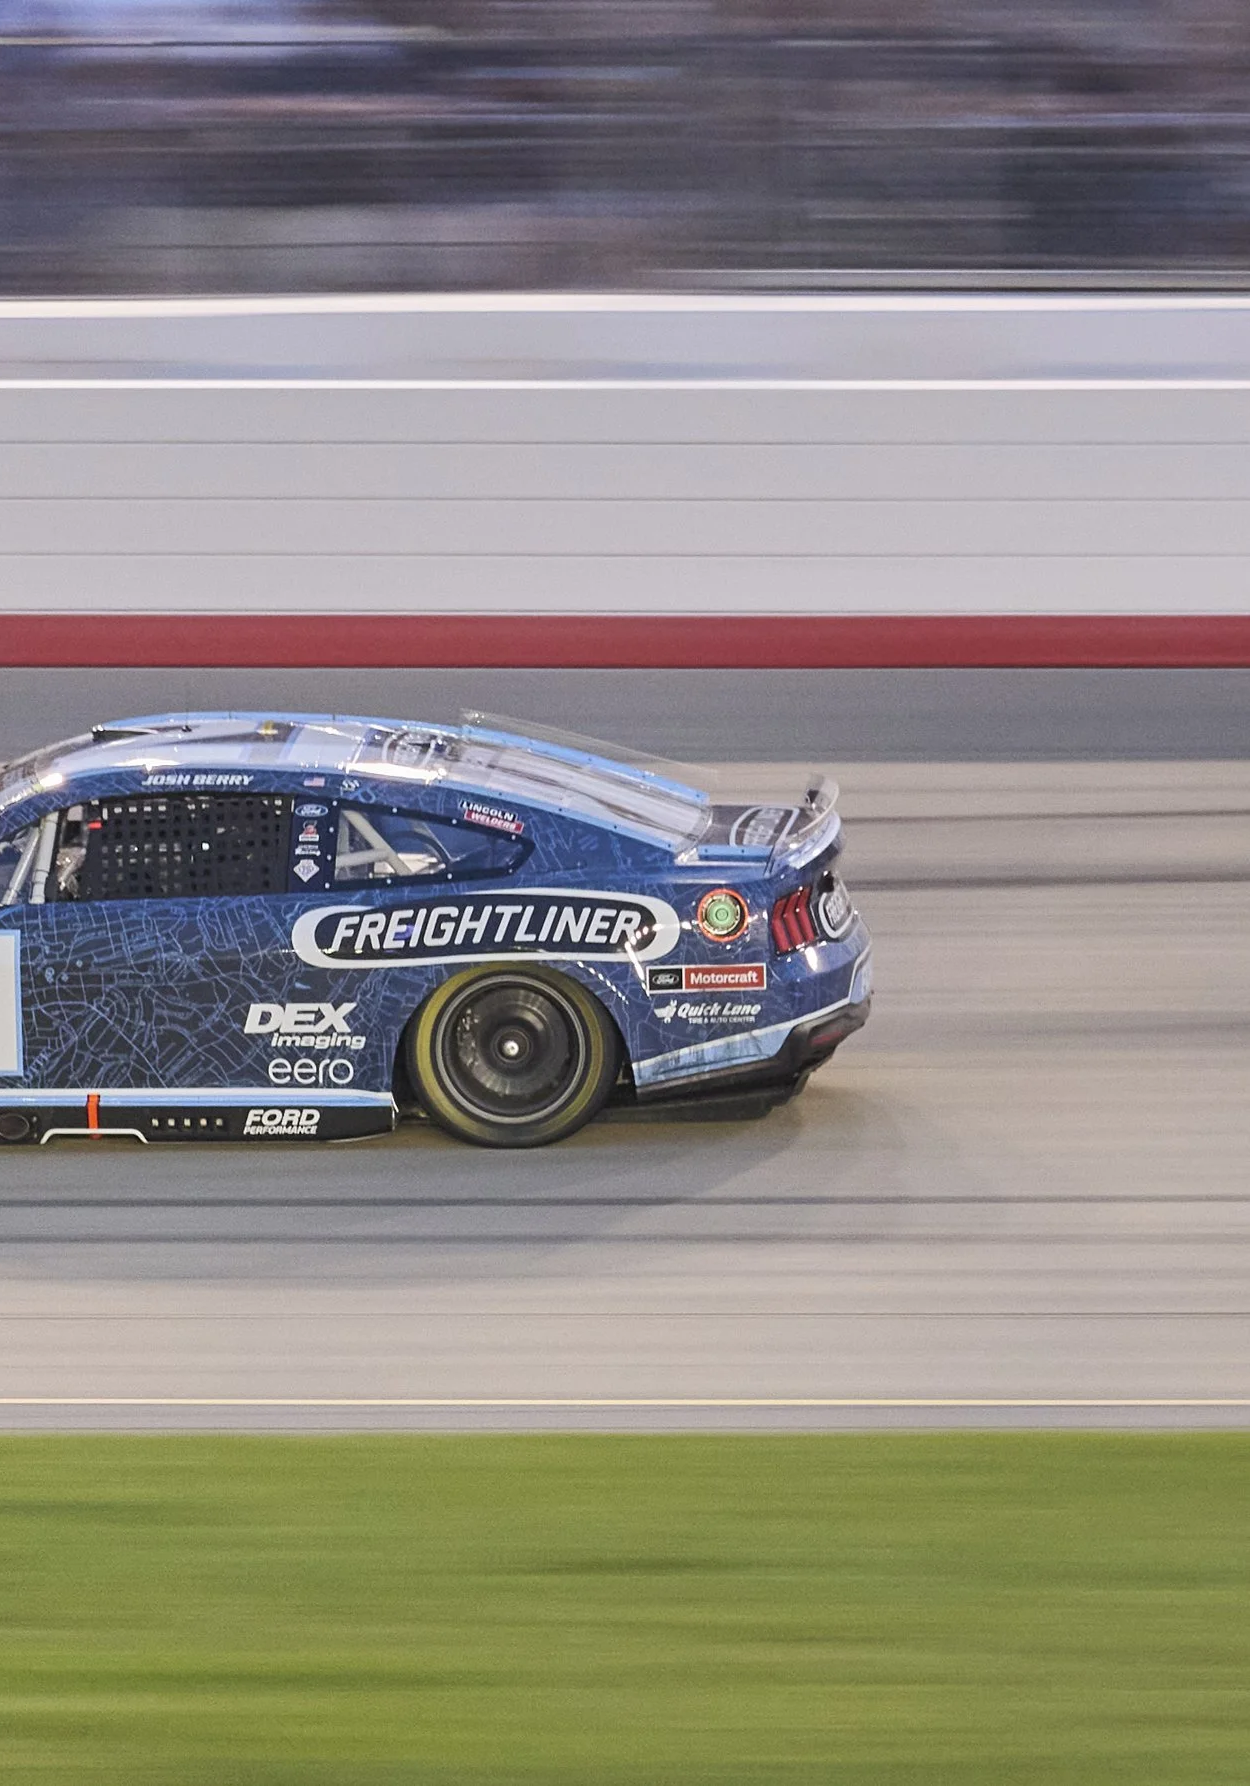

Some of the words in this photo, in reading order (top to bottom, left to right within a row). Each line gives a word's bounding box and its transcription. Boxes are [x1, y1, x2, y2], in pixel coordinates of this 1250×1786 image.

[141, 774, 191, 786] JOSH
[193, 774, 254, 786] BERRY
[462, 801, 514, 821] LINCOLN
[331, 905, 641, 951] FREIGHTLINER
[690, 970, 759, 985] Motorcraft
[244, 1002, 357, 1034] DEX
[677, 1002, 722, 1019] Quick
[722, 1002, 762, 1016] Lane
[271, 1032, 366, 1049] imaging
[268, 1057, 354, 1084] eero
[245, 1108, 320, 1126] FORD
[243, 1125, 318, 1135] PERFORMANCE
